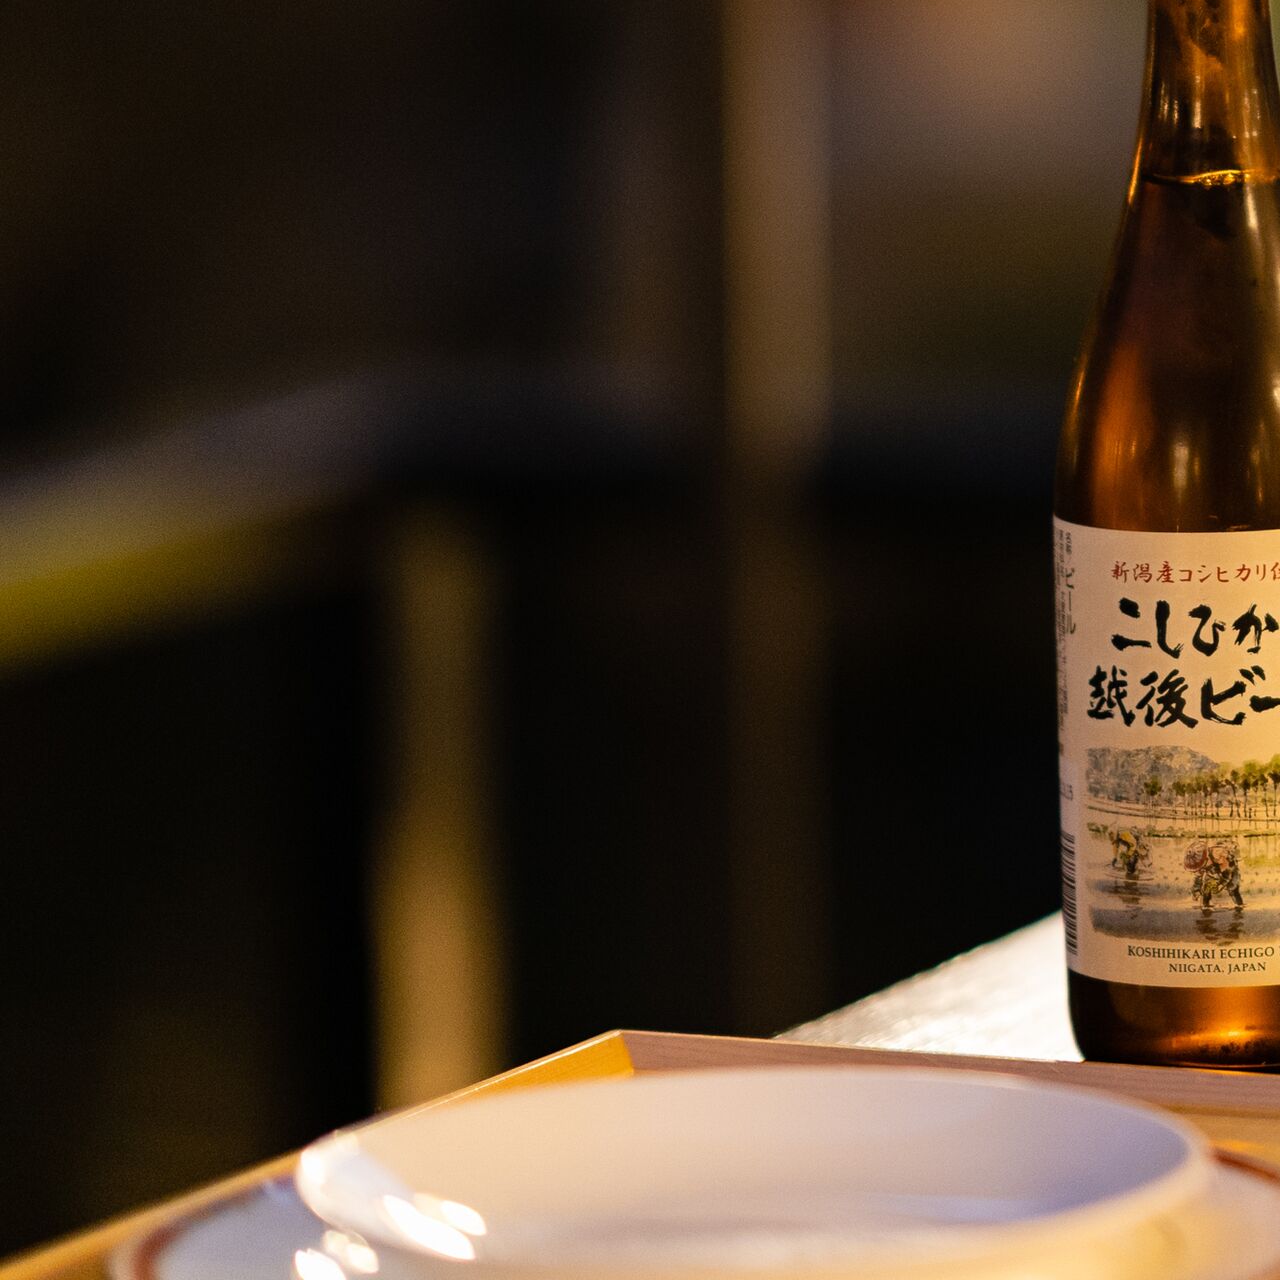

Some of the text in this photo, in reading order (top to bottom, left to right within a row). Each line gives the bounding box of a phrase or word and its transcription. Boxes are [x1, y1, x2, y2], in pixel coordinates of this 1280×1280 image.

[1127, 944, 1216, 959] KOSHIHIKARI
[1219, 946, 1275, 959] ECHIGO
[1227, 962, 1267, 975] JAPAN
